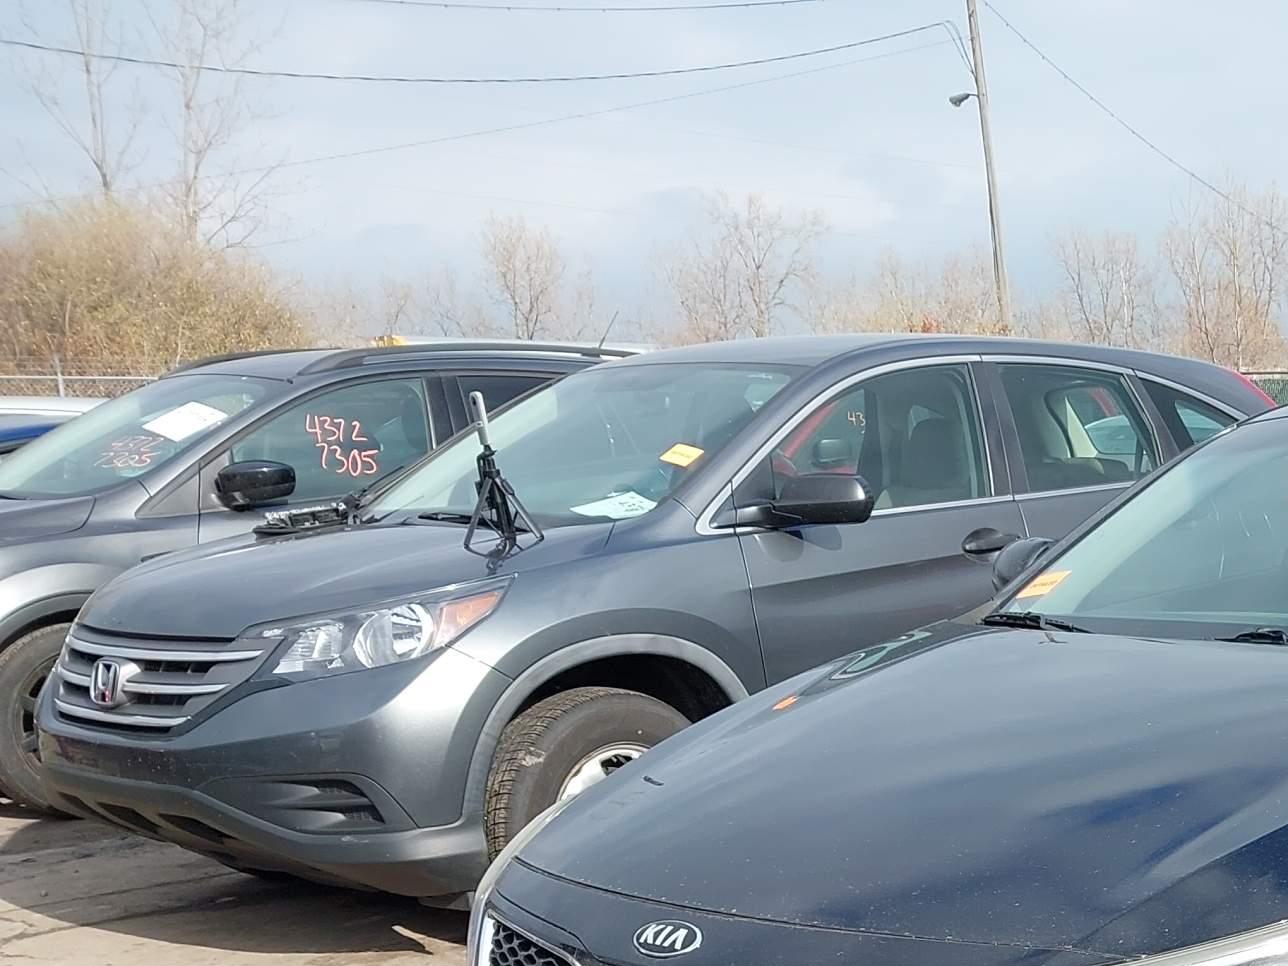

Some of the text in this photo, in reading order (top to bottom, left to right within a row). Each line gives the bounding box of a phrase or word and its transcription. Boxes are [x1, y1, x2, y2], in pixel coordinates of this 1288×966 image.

[305, 413, 369, 443] 4372
[315, 442, 379, 477] 7305
[638, 923, 689, 950] KIA
